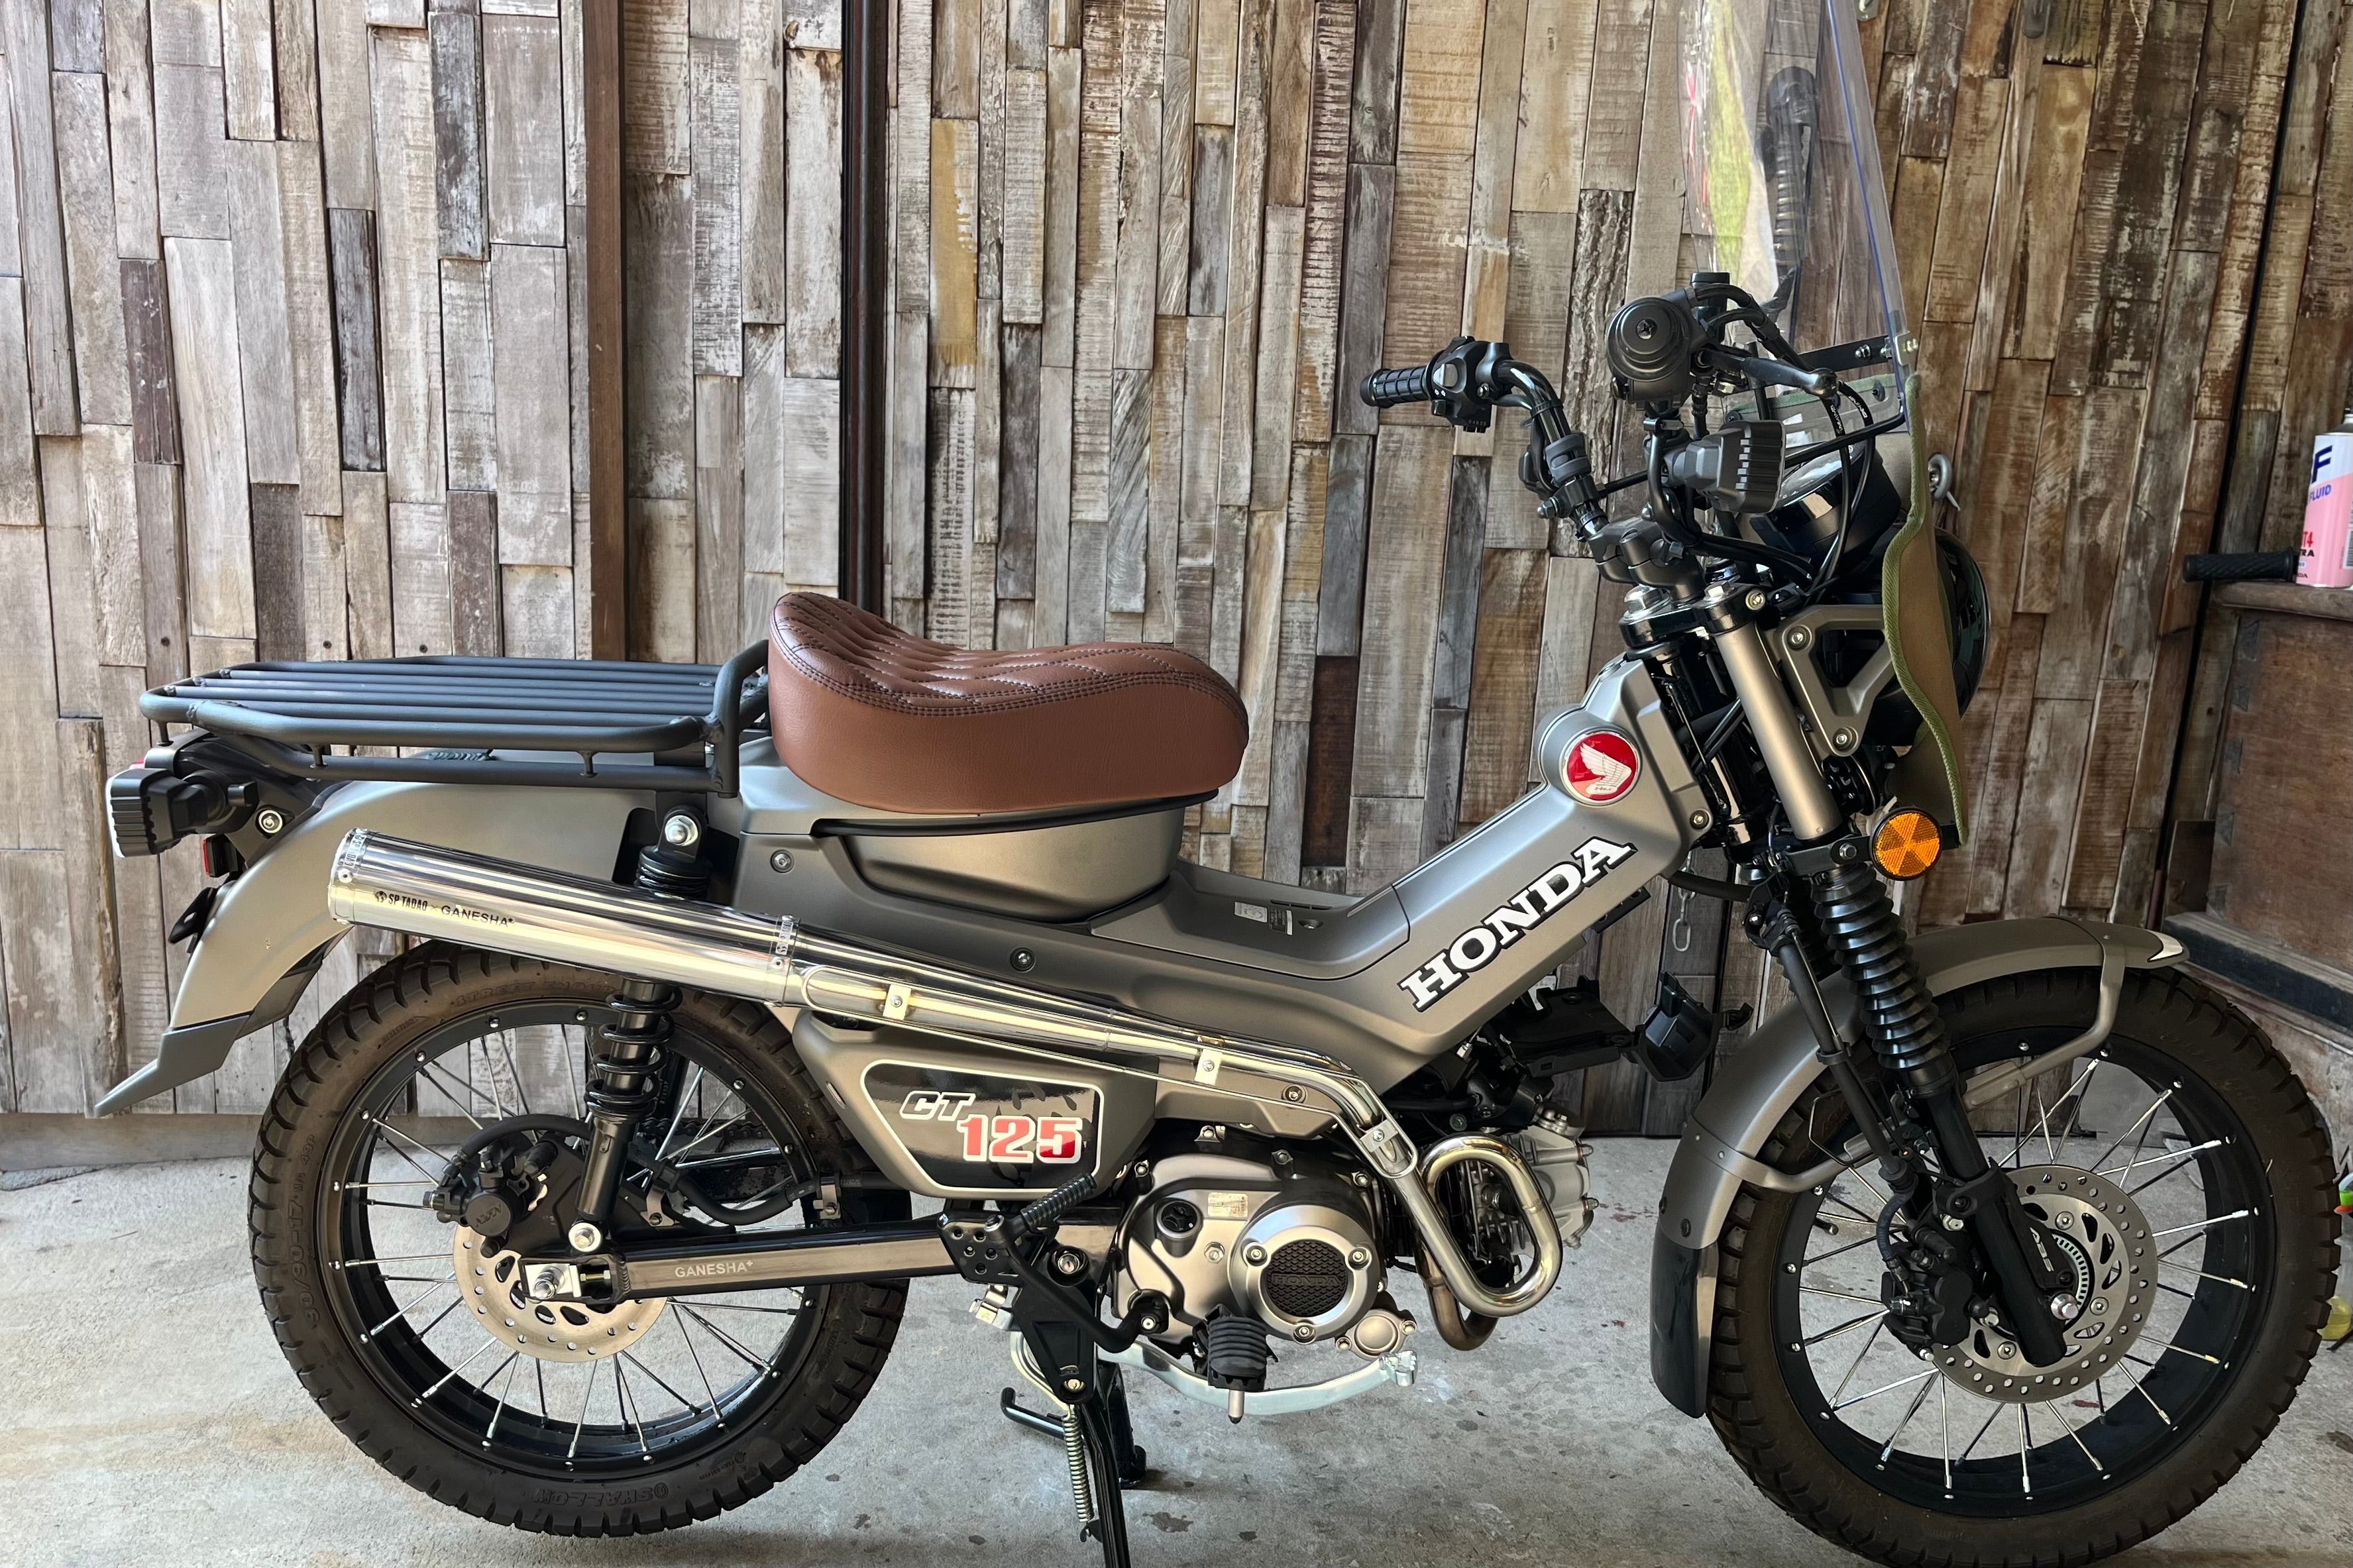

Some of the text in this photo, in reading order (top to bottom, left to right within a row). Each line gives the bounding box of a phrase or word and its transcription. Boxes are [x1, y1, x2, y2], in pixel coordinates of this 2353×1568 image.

[2308, 484, 2332, 503] FLUID
[388, 894, 400, 906] SP
[402, 896, 428, 912] TADAO
[1397, 836, 1638, 1013] HONDA
[456, 981, 622, 1008] STREET ENDUR
[899, 1090, 977, 1122] CT
[956, 1114, 1083, 1164] 125
[2029, 1226, 2055, 1272] ABS
[1272, 1275, 1340, 1284] HONDA
